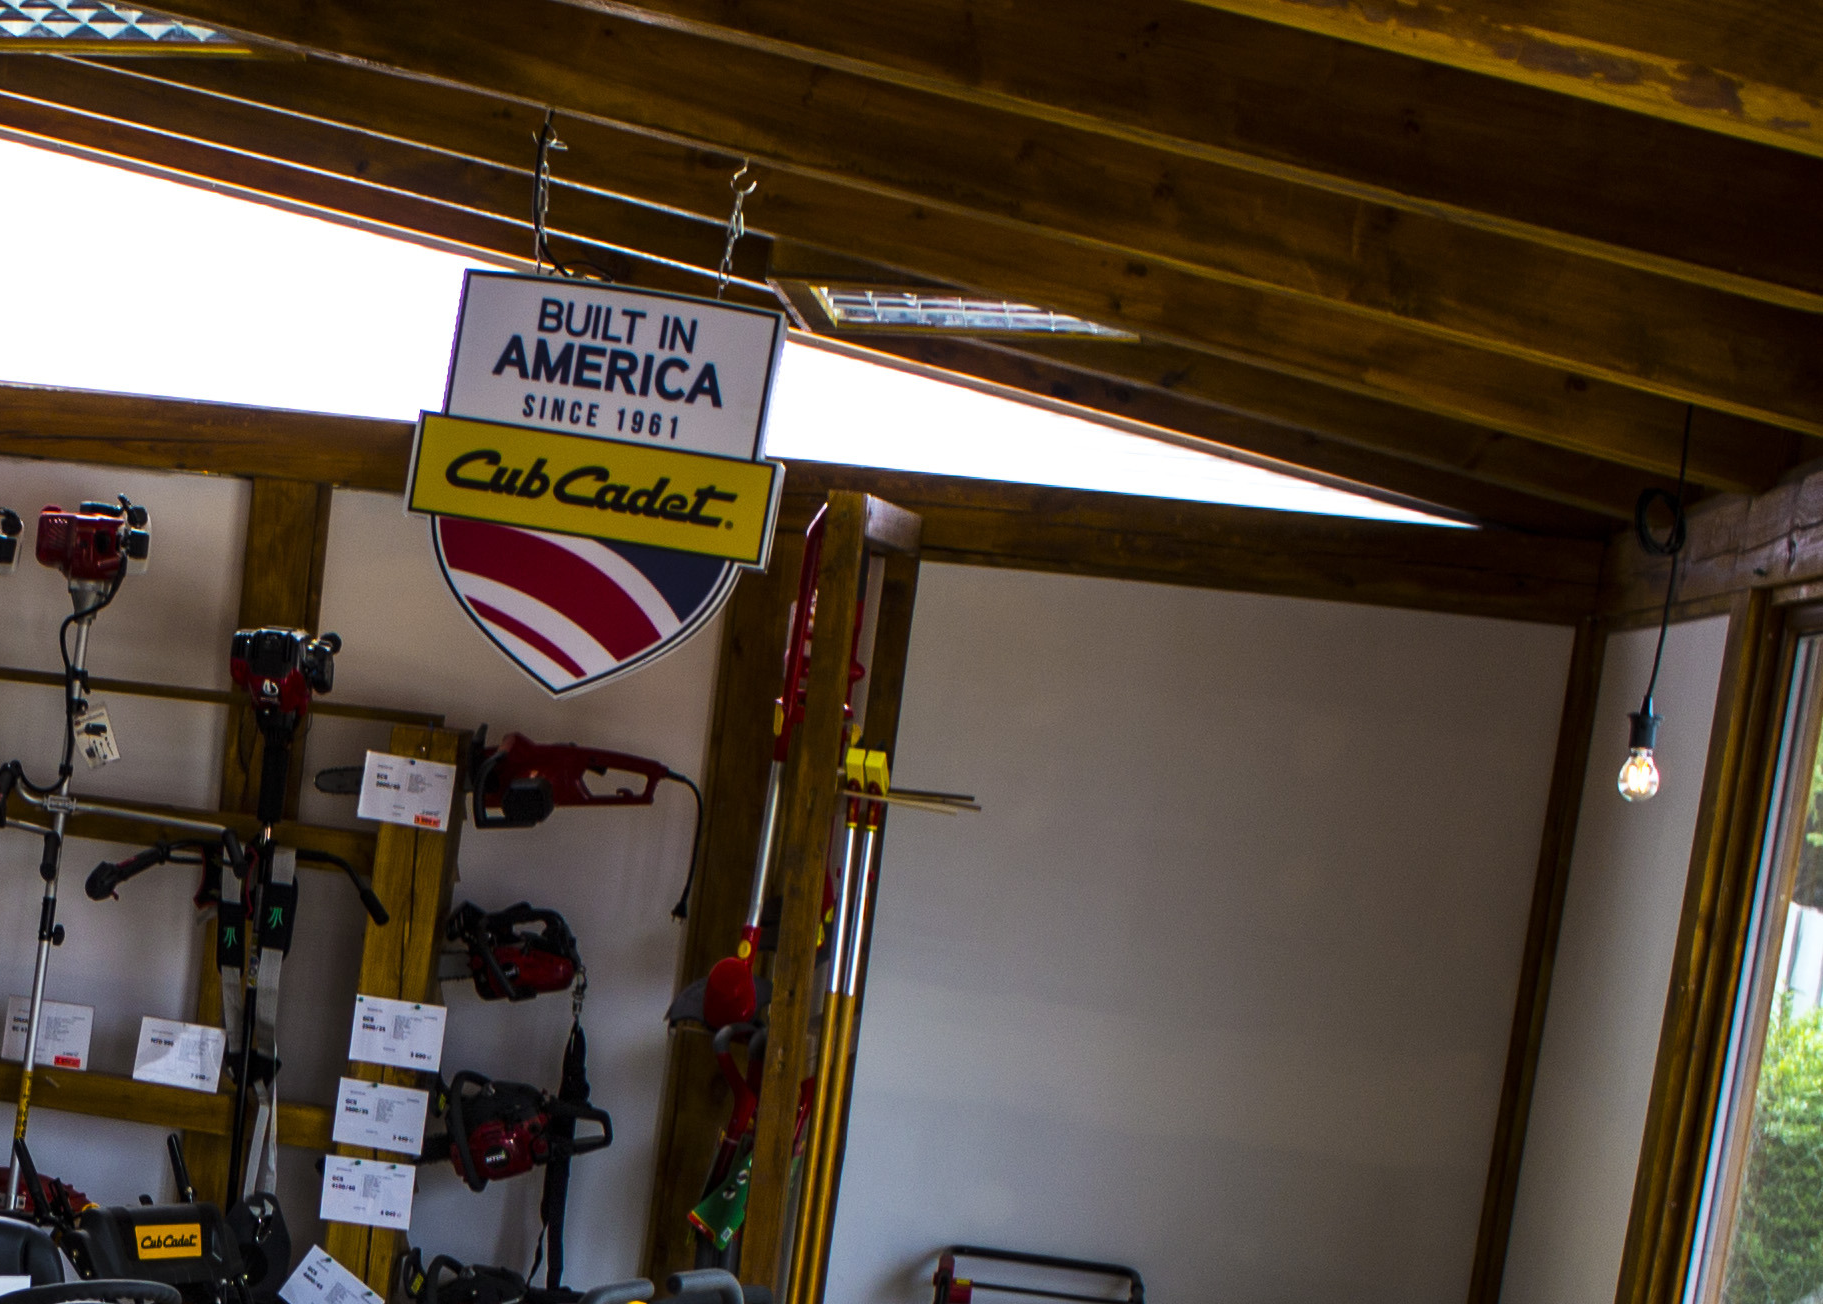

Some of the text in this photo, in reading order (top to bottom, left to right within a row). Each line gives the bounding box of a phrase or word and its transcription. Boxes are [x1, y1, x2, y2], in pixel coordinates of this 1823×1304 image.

[537, 297, 698, 354] BUILT IN
[492, 334, 722, 409] AMERICA
[522, 392, 678, 439] SINCE 1961
[445, 449, 738, 527] Cub Cadet
[141, 1234, 197, 1249] Cub Cadet
